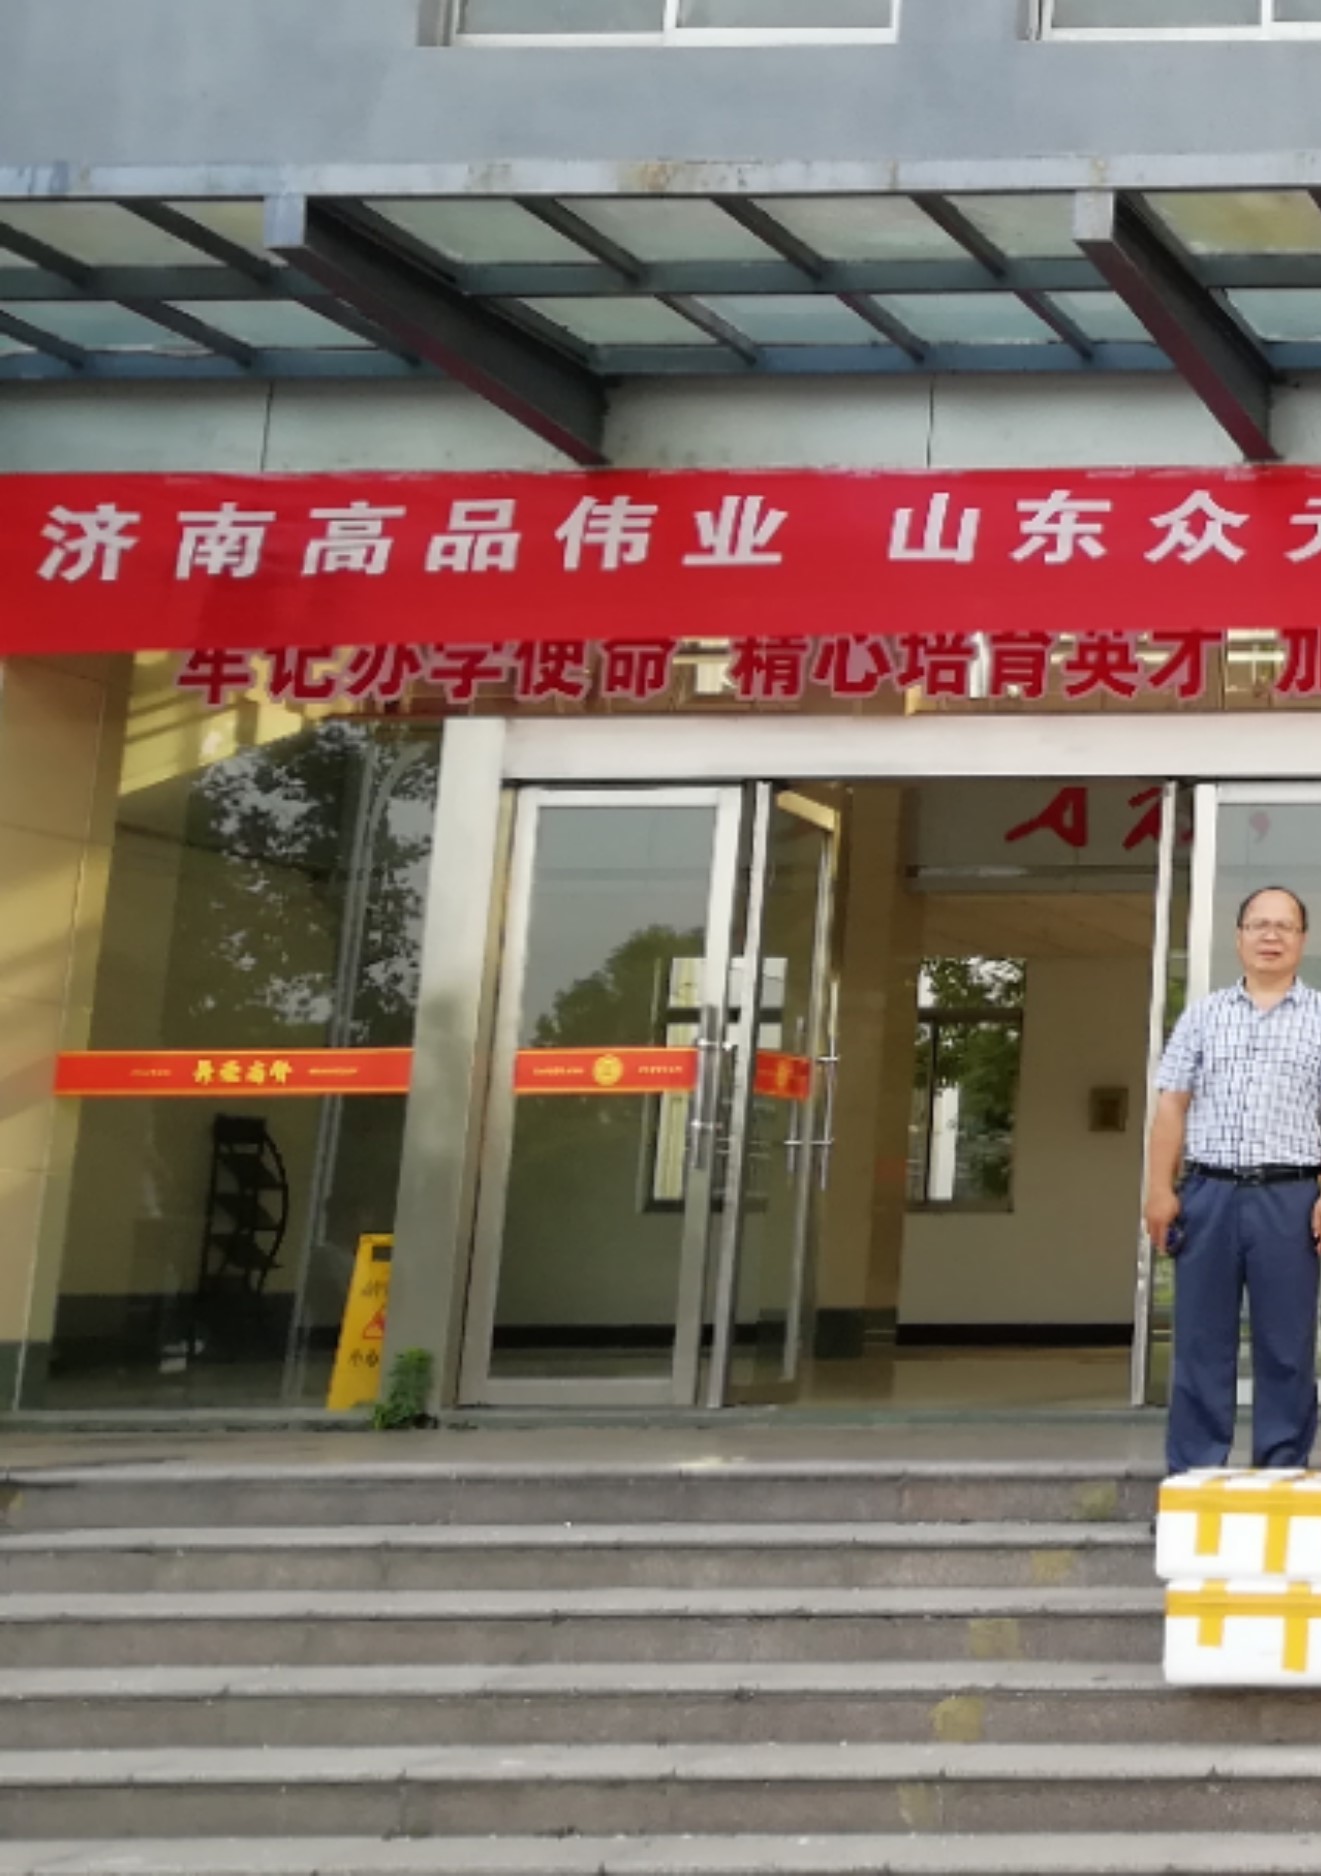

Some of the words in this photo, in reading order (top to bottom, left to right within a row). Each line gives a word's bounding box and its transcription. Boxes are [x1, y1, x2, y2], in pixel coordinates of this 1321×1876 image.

[37, 492, 787, 582] 济南高品伟业
